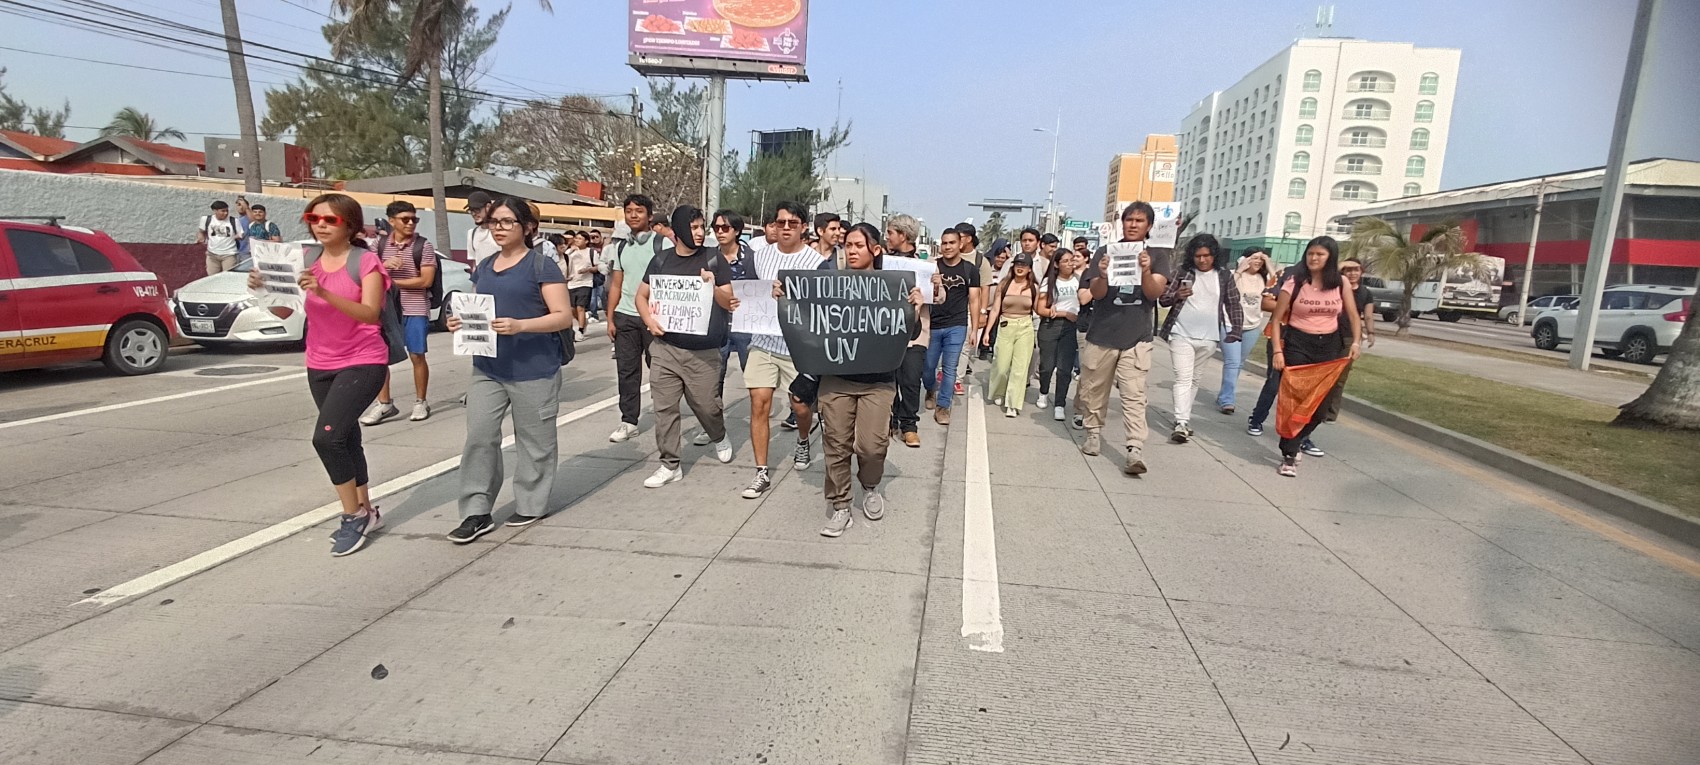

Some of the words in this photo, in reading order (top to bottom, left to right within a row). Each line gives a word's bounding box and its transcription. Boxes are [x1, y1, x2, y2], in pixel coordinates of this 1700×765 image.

[651, 278, 703, 290] UNIVERSIDAD
[785, 276, 809, 300] NO
[813, 275, 892, 302] TOLERANCIA
[898, 278, 910, 301] A
[133, 286, 159, 297] VB-4724
[653, 290, 700, 302] VERACRUZANA
[1299, 298, 1321, 306] GOOD
[650, 301, 660, 315] NO
[662, 304, 702, 318] ELIMINES
[668, 316, 684, 330] PRE
[787, 303, 803, 325] LA
[810, 303, 907, 335] INSOLENCIA
[824, 337, 859, 364] UV
